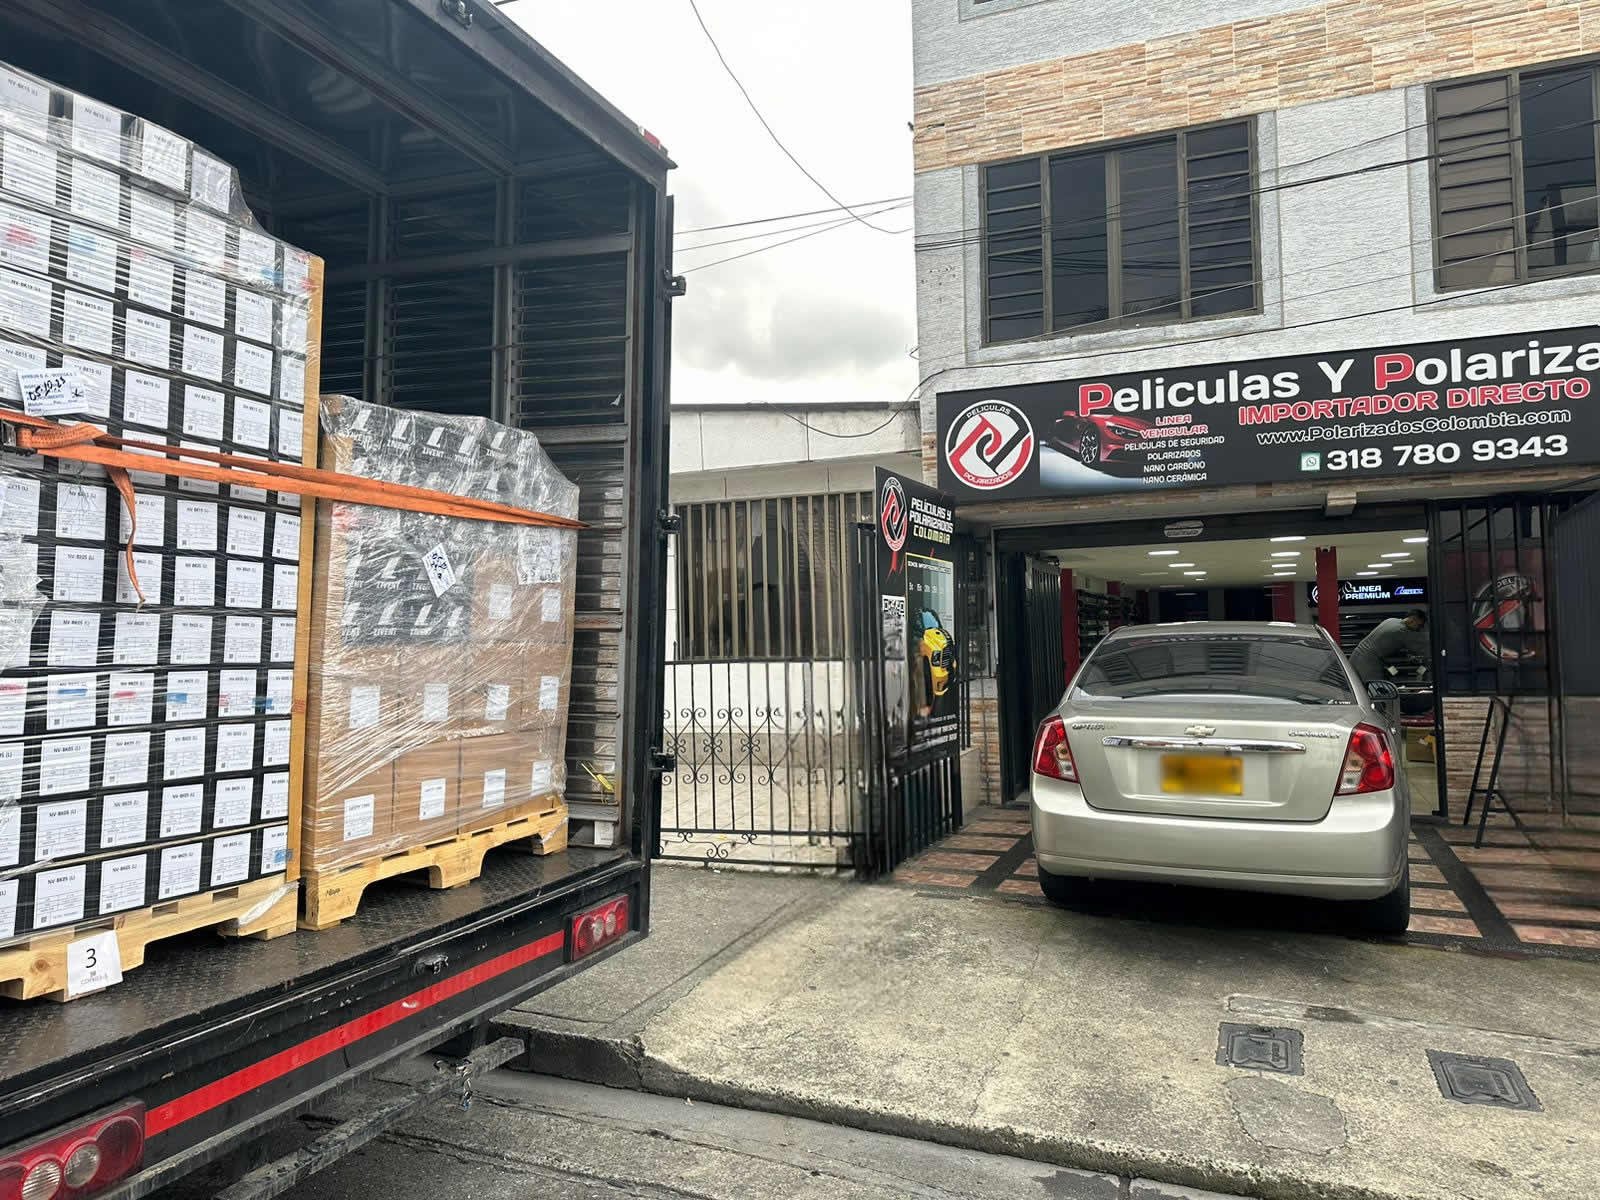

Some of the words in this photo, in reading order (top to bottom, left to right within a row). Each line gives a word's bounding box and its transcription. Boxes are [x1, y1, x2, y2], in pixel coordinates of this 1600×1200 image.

[1079, 369, 1301, 417] Peliculas
[1317, 359, 1355, 393] Y
[1239, 391, 1439, 425] IMPORTADOR
[1446, 377, 1591, 408] DIRECTO
[966, 404, 1011, 418] PELICULAS
[1155, 414, 1192, 426] LINEA
[1256, 410, 1571, 445] www.PolarizadosColombia.com
[1140, 424, 1208, 439] VEHICULAR
[1124, 440, 1166, 451] PELICULAS
[1168, 439, 1178, 447] DE
[1180, 436, 1225, 447] SEGURIDAD
[1147, 449, 1201, 461] POLARIZADOS
[1326, 447, 1383, 470] 318
[1392, 442, 1461, 466] 780
[1472, 434, 1569, 461] 9343
[1143, 464, 1166, 473] NANO
[1167, 461, 1206, 471] CARBONO
[1142, 475, 1165, 484] NANO
[909, 510, 954, 534] POLARIZADOS
[913, 525, 951, 545] COLOMBIA
[1345, 591, 1391, 600] PREMIUM
[1353, 585, 1382, 593] LINEA
[86, 948, 97, 968] 3
